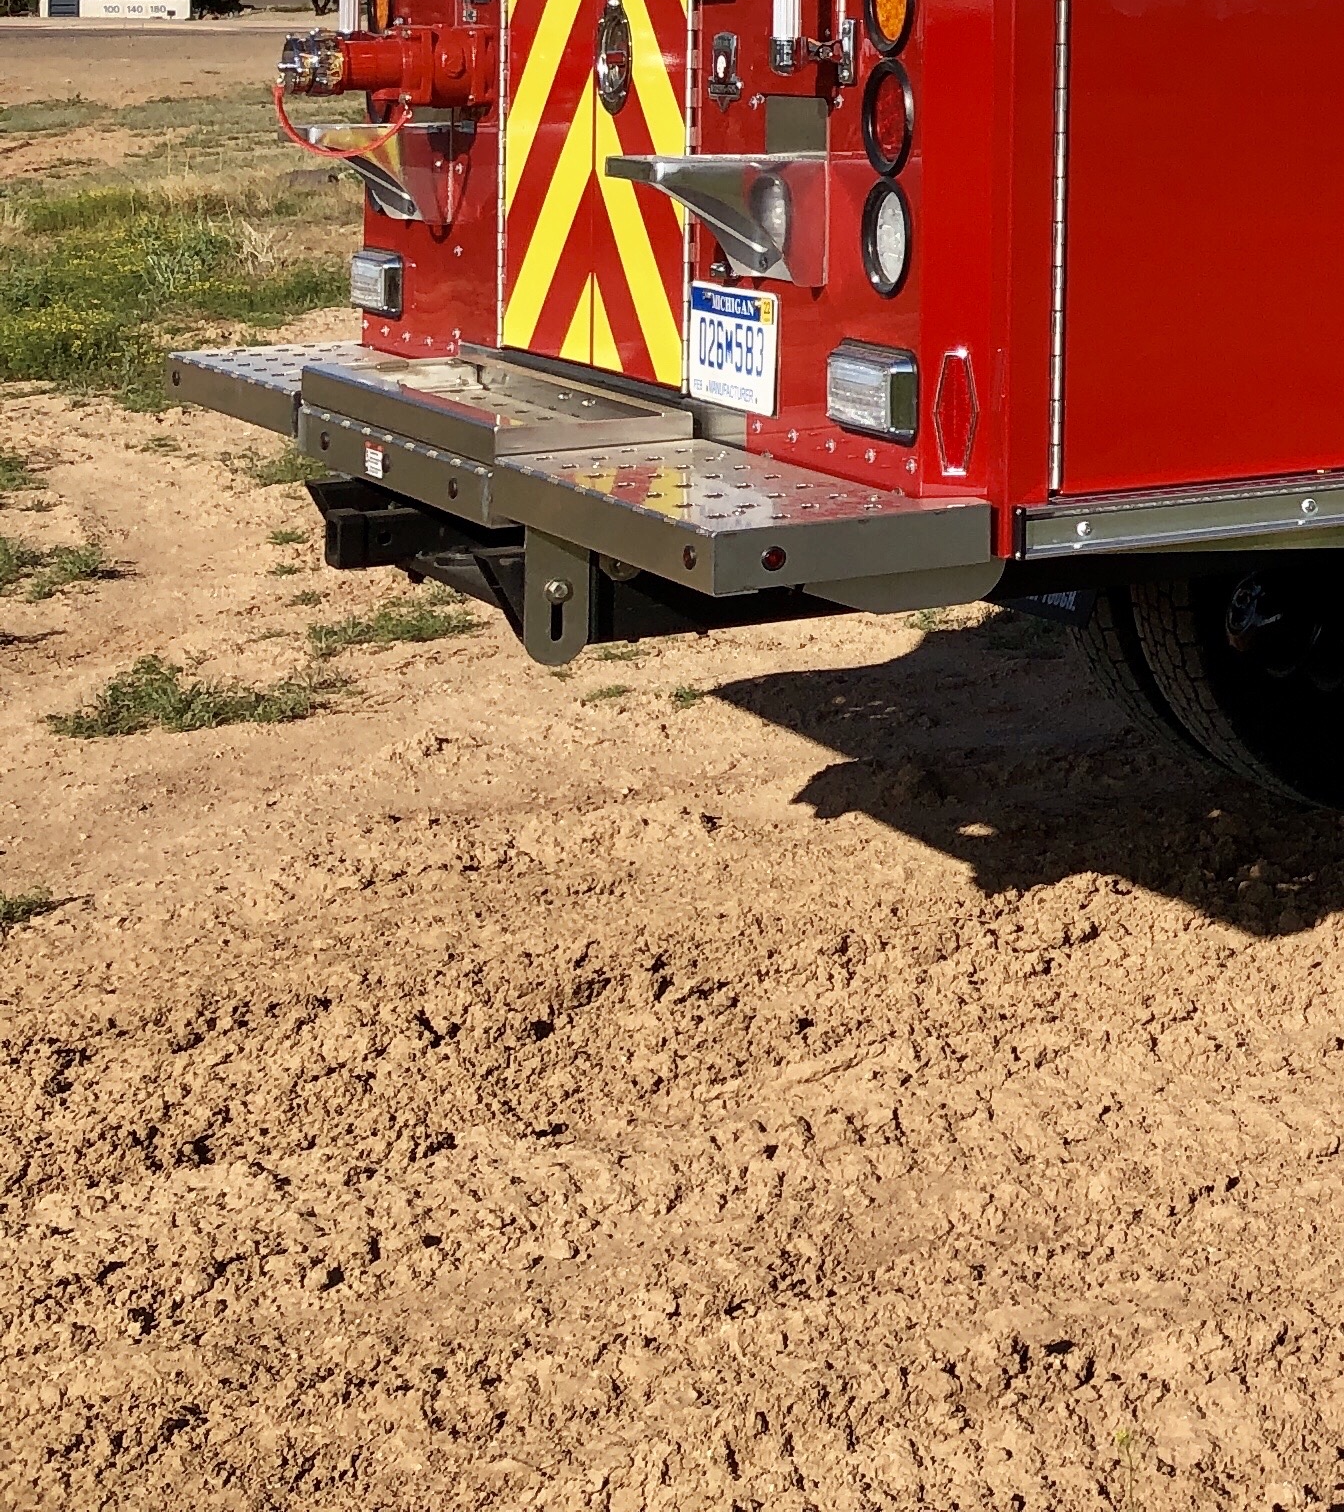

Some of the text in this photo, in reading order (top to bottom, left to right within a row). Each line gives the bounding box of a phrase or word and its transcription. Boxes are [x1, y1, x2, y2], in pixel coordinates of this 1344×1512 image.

[103, 5, 120, 14] 100
[126, 5, 144, 14] 140
[711, 292, 755, 316] MICHIGAN
[699, 316, 765, 378] 026M583
